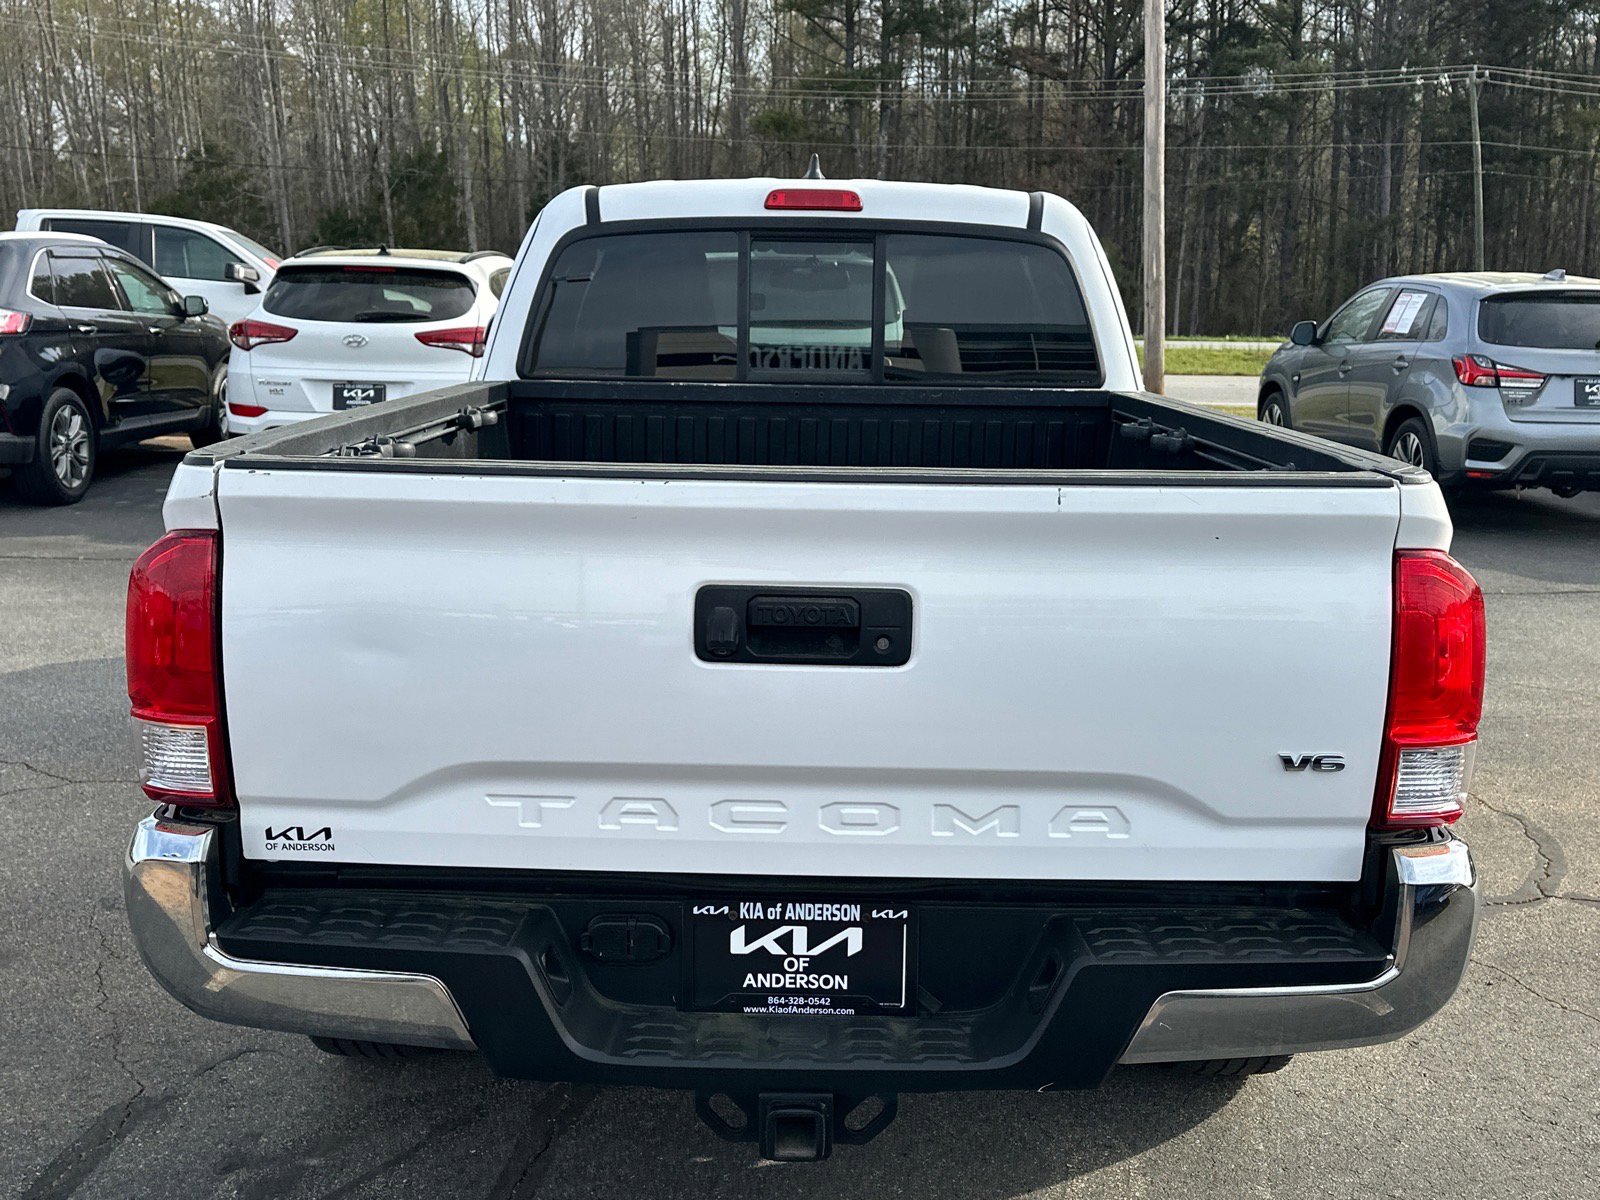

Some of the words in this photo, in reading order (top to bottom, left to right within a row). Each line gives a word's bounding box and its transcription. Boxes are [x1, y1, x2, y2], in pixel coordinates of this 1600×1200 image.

[343, 389, 374, 397] KIA
[757, 606, 853, 625] TOYOTA
[1278, 752, 1345, 772] V6
[485, 794, 1130, 839] TACOMA
[265, 826, 332, 841] KIA
[265, 842, 278, 851] OF
[281, 843, 335, 851] ANDERSON
[693, 905, 729, 915] KIA
[740, 902, 764, 920] KIA
[767, 903, 782, 920] of
[784, 903, 861, 922] ANDERSON
[872, 909, 908, 919] KIA
[730, 925, 863, 957] KIA
[783, 957, 810, 972] OF
[742, 973, 848, 990] ANDERSON
[767, 996, 831, 1006] 864-328-0542
[743, 1005, 855, 1016] www.KiaofAnderson.com
